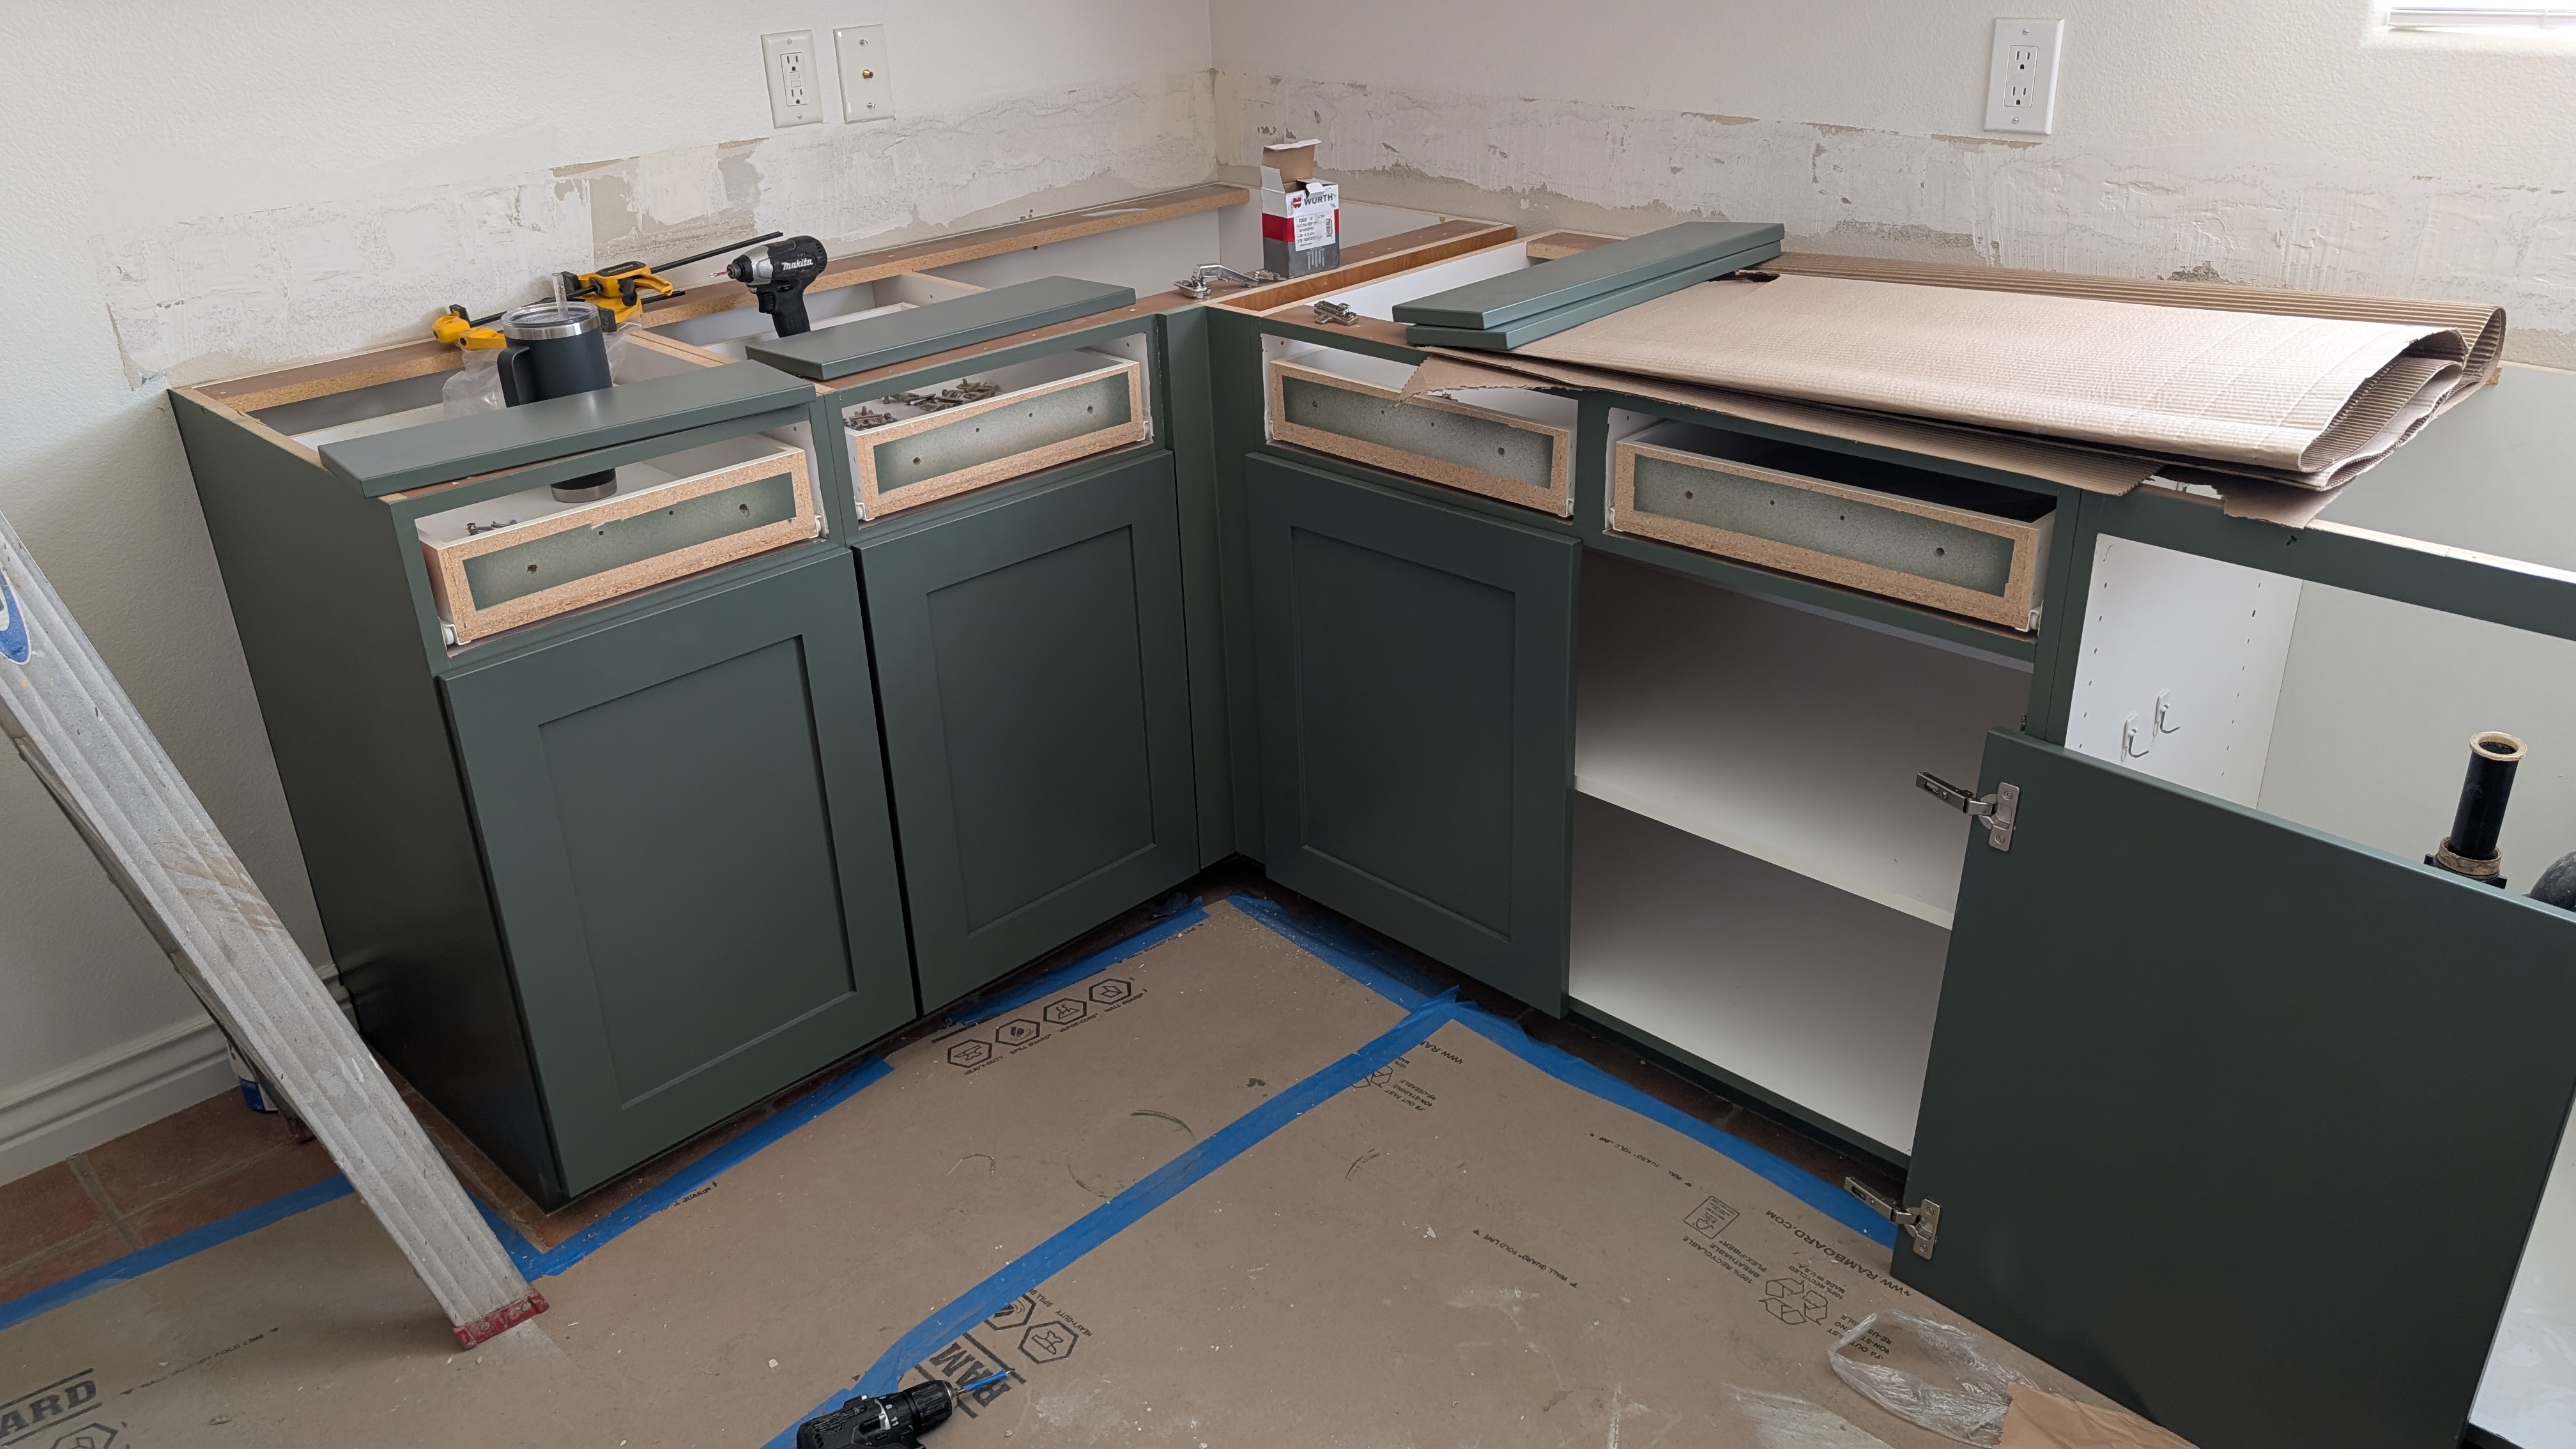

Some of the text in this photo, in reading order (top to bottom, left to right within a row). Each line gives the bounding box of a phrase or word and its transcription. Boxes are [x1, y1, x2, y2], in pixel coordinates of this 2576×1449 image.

[1103, 1004, 1122, 1012] WALL
[1009, 1045, 1027, 1055] SPILL
[964, 1055, 1003, 1075] HEAVY-DUTY
[1483, 1234, 1499, 1245] LINE
[1766, 1209, 1912, 1296] WWW.RAMBOARD.COM
[1682, 1236, 1752, 1284] 100% RECYCLABLE
[1709, 1243, 1760, 1278] BREATHABLE
[1549, 1268, 1568, 1282] WALL
[1790, 1266, 1825, 1289] RECYCLED
[1825, 1280, 1845, 1294] MADE
[1036, 1293, 1053, 1307] SPILL
[1055, 1310, 1092, 1337] HEAVY-DUTY
[1850, 1341, 1868, 1353] OUT
[929, 1342, 1011, 1407] RAM
[891, 1416, 899, 1426] 11
